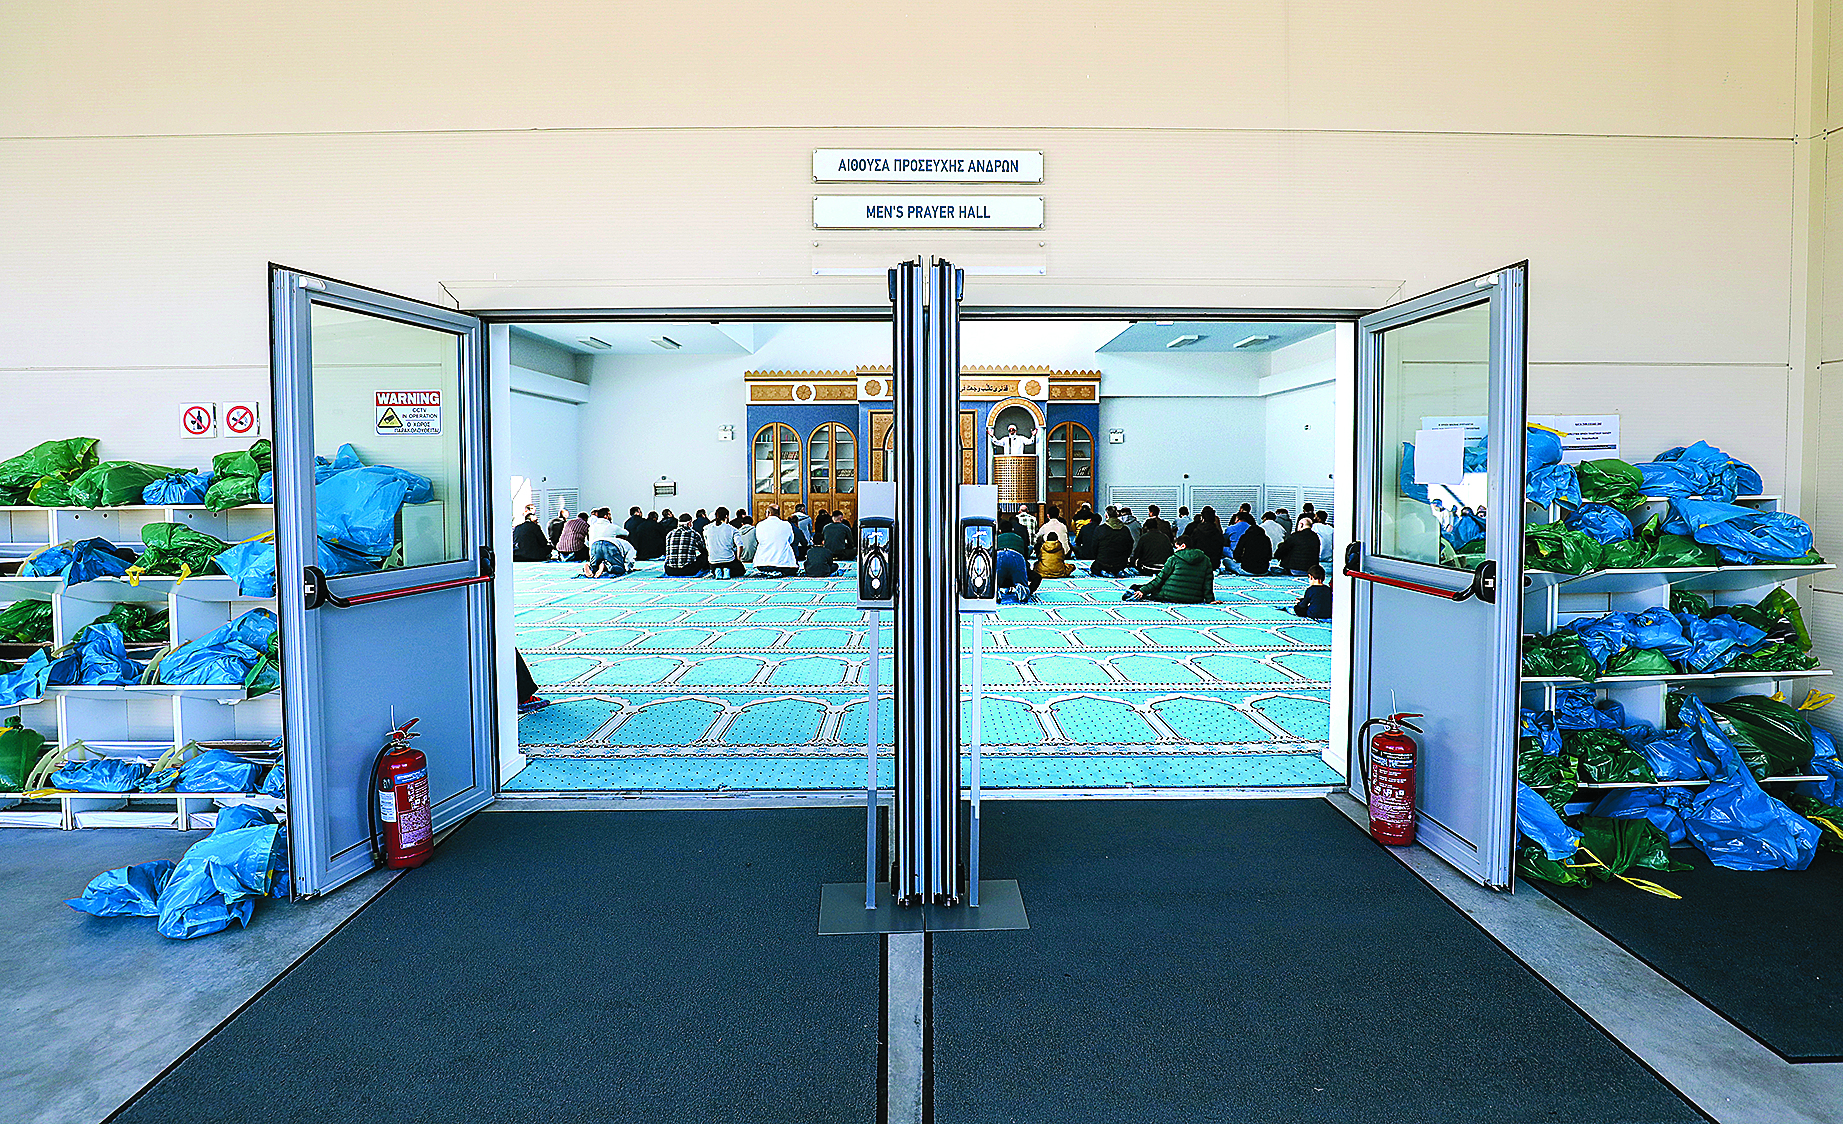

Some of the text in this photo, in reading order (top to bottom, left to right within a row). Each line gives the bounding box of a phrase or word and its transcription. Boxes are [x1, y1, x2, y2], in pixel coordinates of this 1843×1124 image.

[838, 158, 1019, 172] ΑΙΘΟΥΣΑ ΠΡΟΣΕΥΧΗΣ ΑΝΔΡΩΝ
[866, 205, 991, 218] MEN'S PRAYER HALL
[376, 392, 440, 405] WARNING
